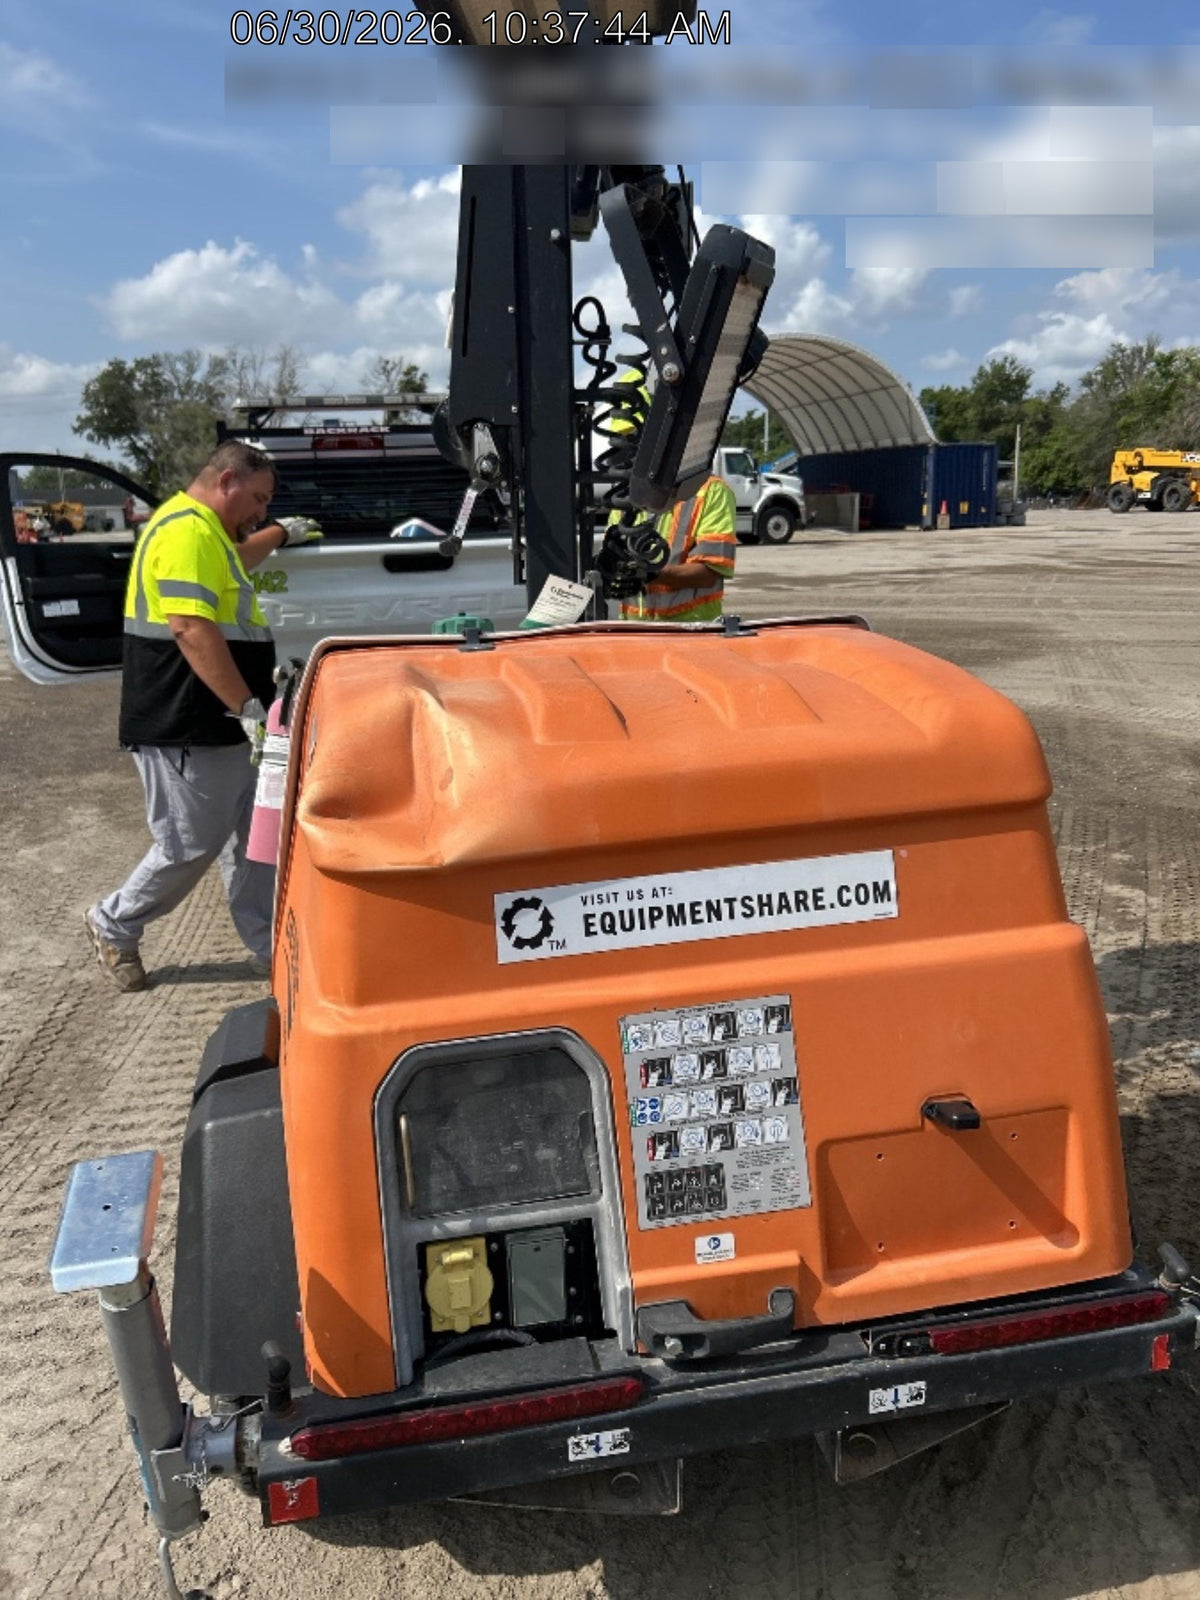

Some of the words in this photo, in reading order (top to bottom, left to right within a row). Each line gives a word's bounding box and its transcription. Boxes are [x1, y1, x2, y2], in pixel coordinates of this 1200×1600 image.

[304, 426, 391, 435] BACKRACK
[580, 891, 620, 907] VISIT
[626, 889, 645, 901] US
[651, 887, 673, 899] AT:
[583, 879, 892, 938] EQUIPMENTSHARE.COM
[547, 938, 567, 951] TM
